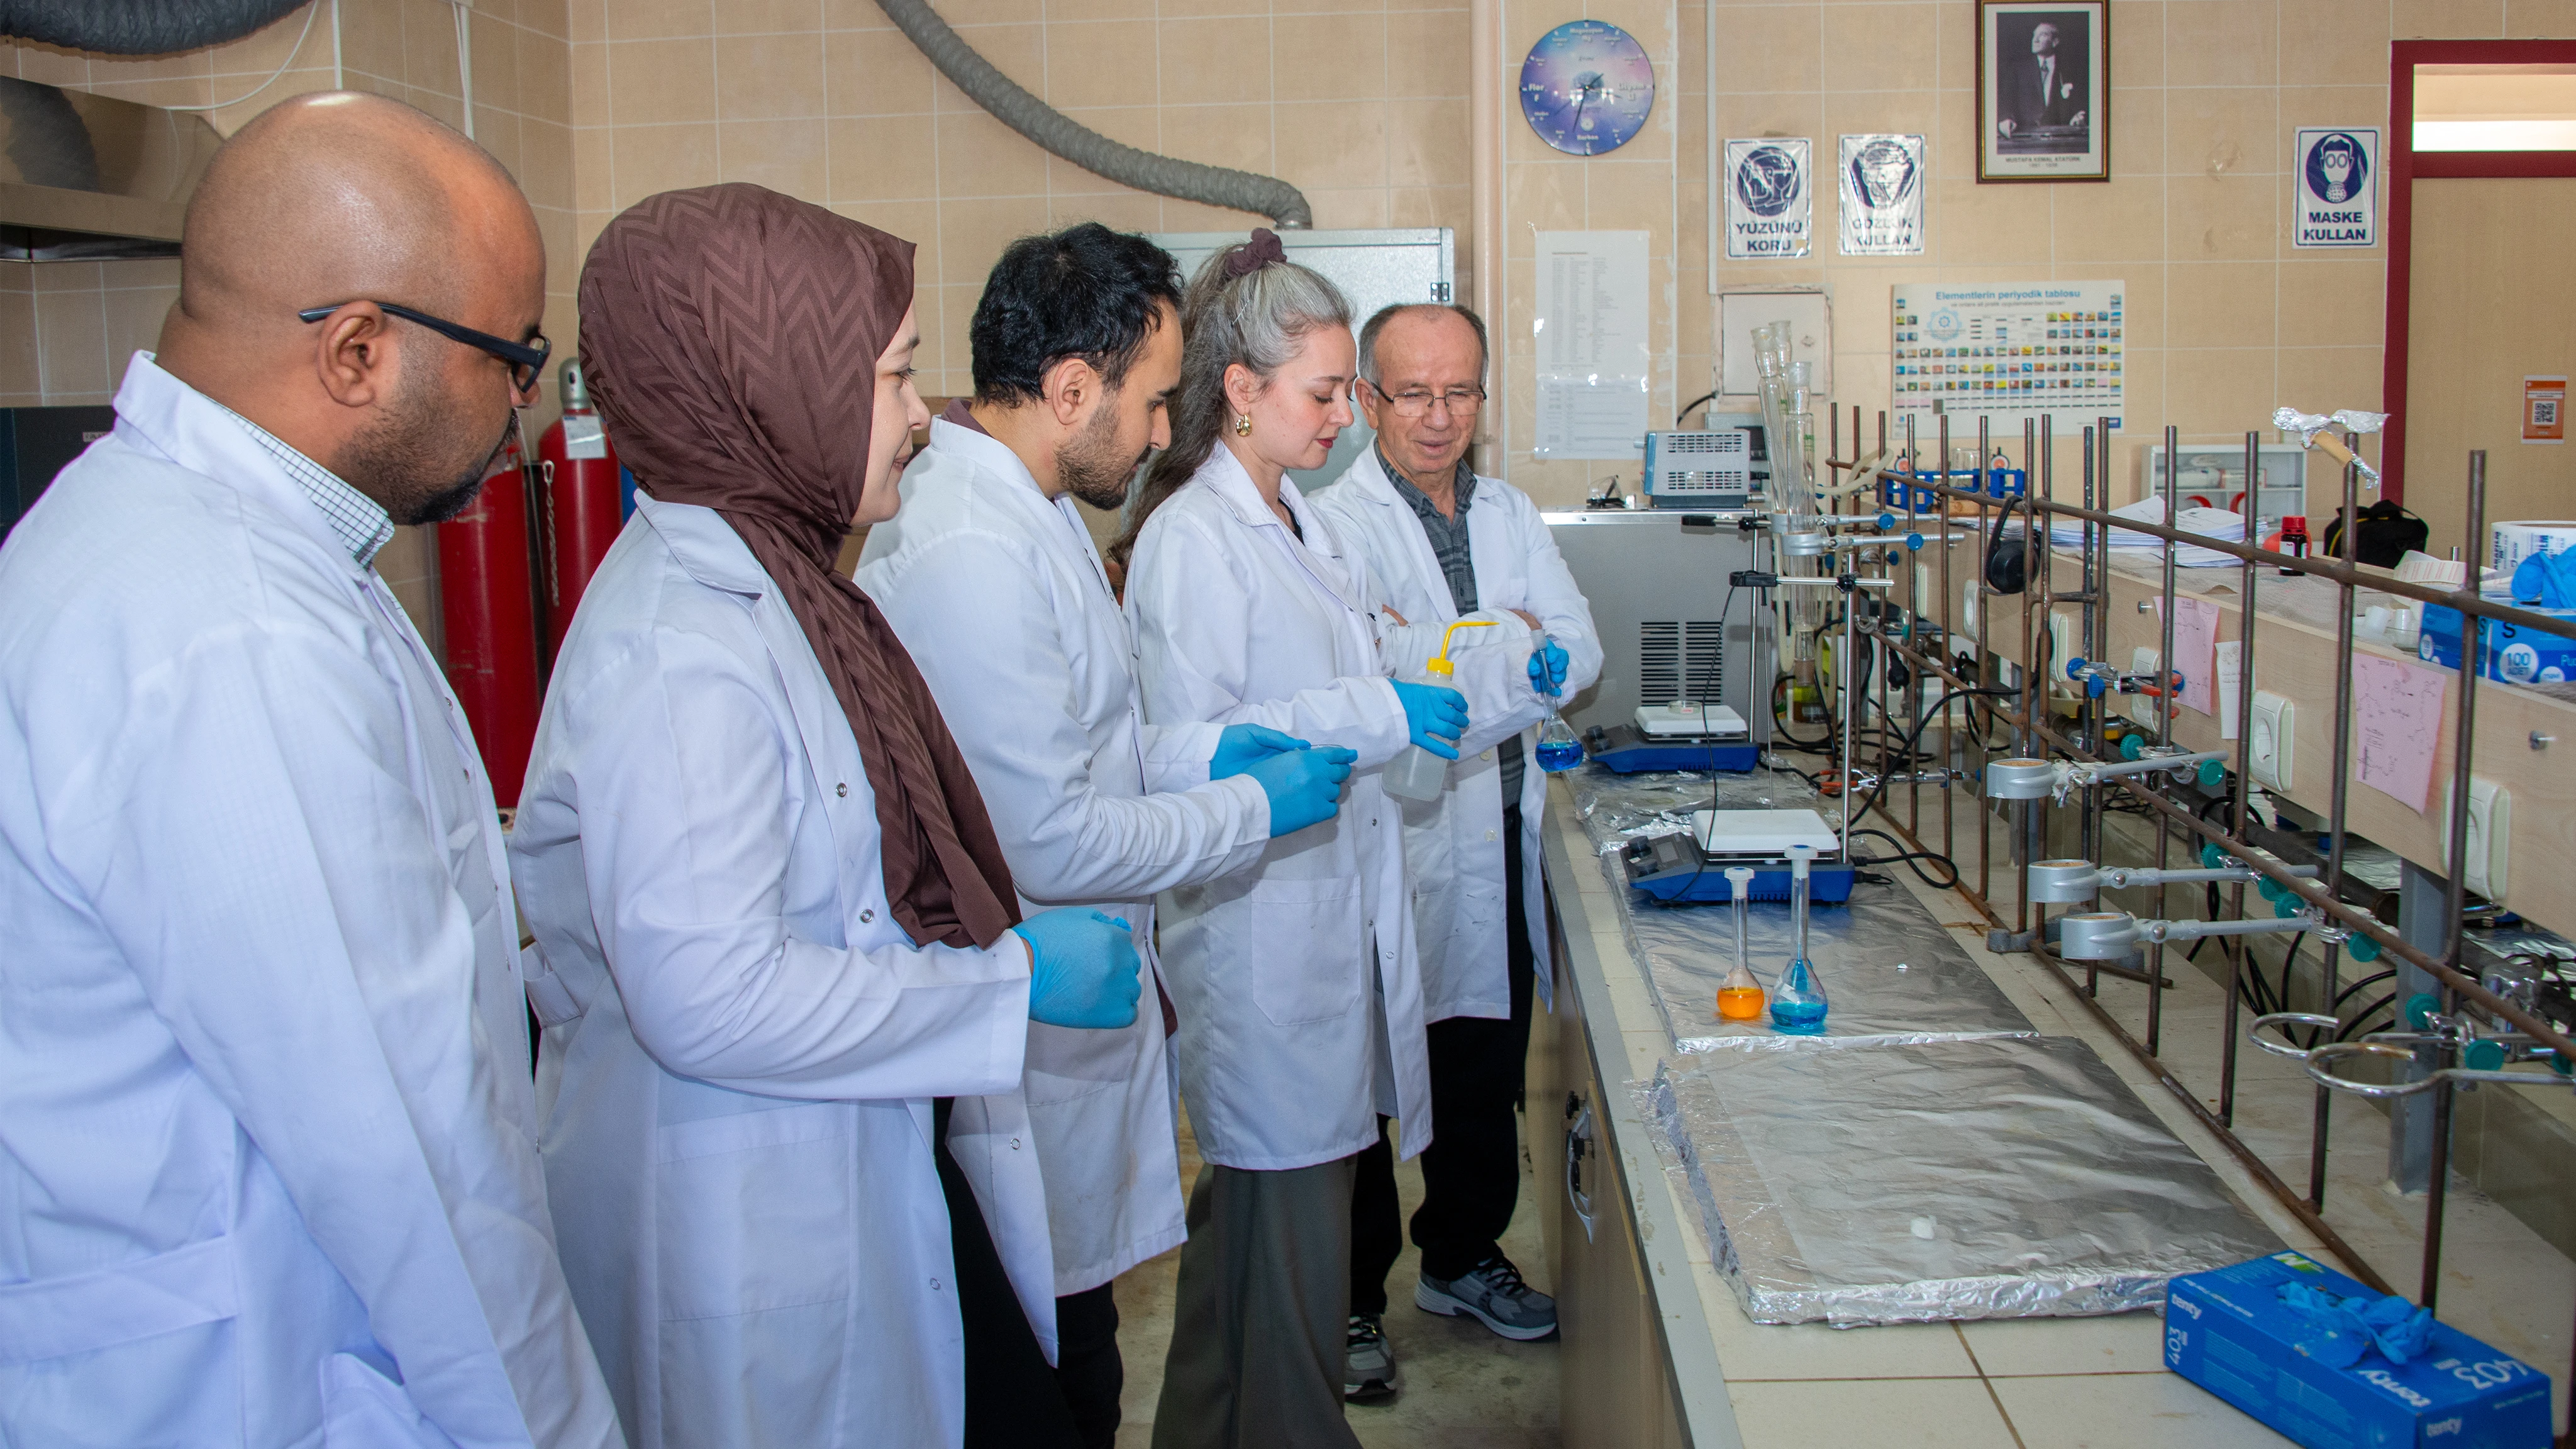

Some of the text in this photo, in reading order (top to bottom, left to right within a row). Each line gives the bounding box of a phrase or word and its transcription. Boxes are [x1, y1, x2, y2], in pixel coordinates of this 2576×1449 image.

[2309, 212, 2363, 223] MASKE
[1736, 219, 1802, 235] YÜZÜNÜ
[2304, 229, 2366, 240] KULLAN
[1747, 240, 1791, 252] KORU
[1936, 289, 2081, 301] Elementlerin periyodik tablosu
[2502, 622, 2516, 639] S
[2507, 652, 2531, 667] 100
[2171, 1293, 2202, 1320] tenty
[2167, 1325, 2182, 1365] 403
[2453, 1358, 2529, 1390] 403
